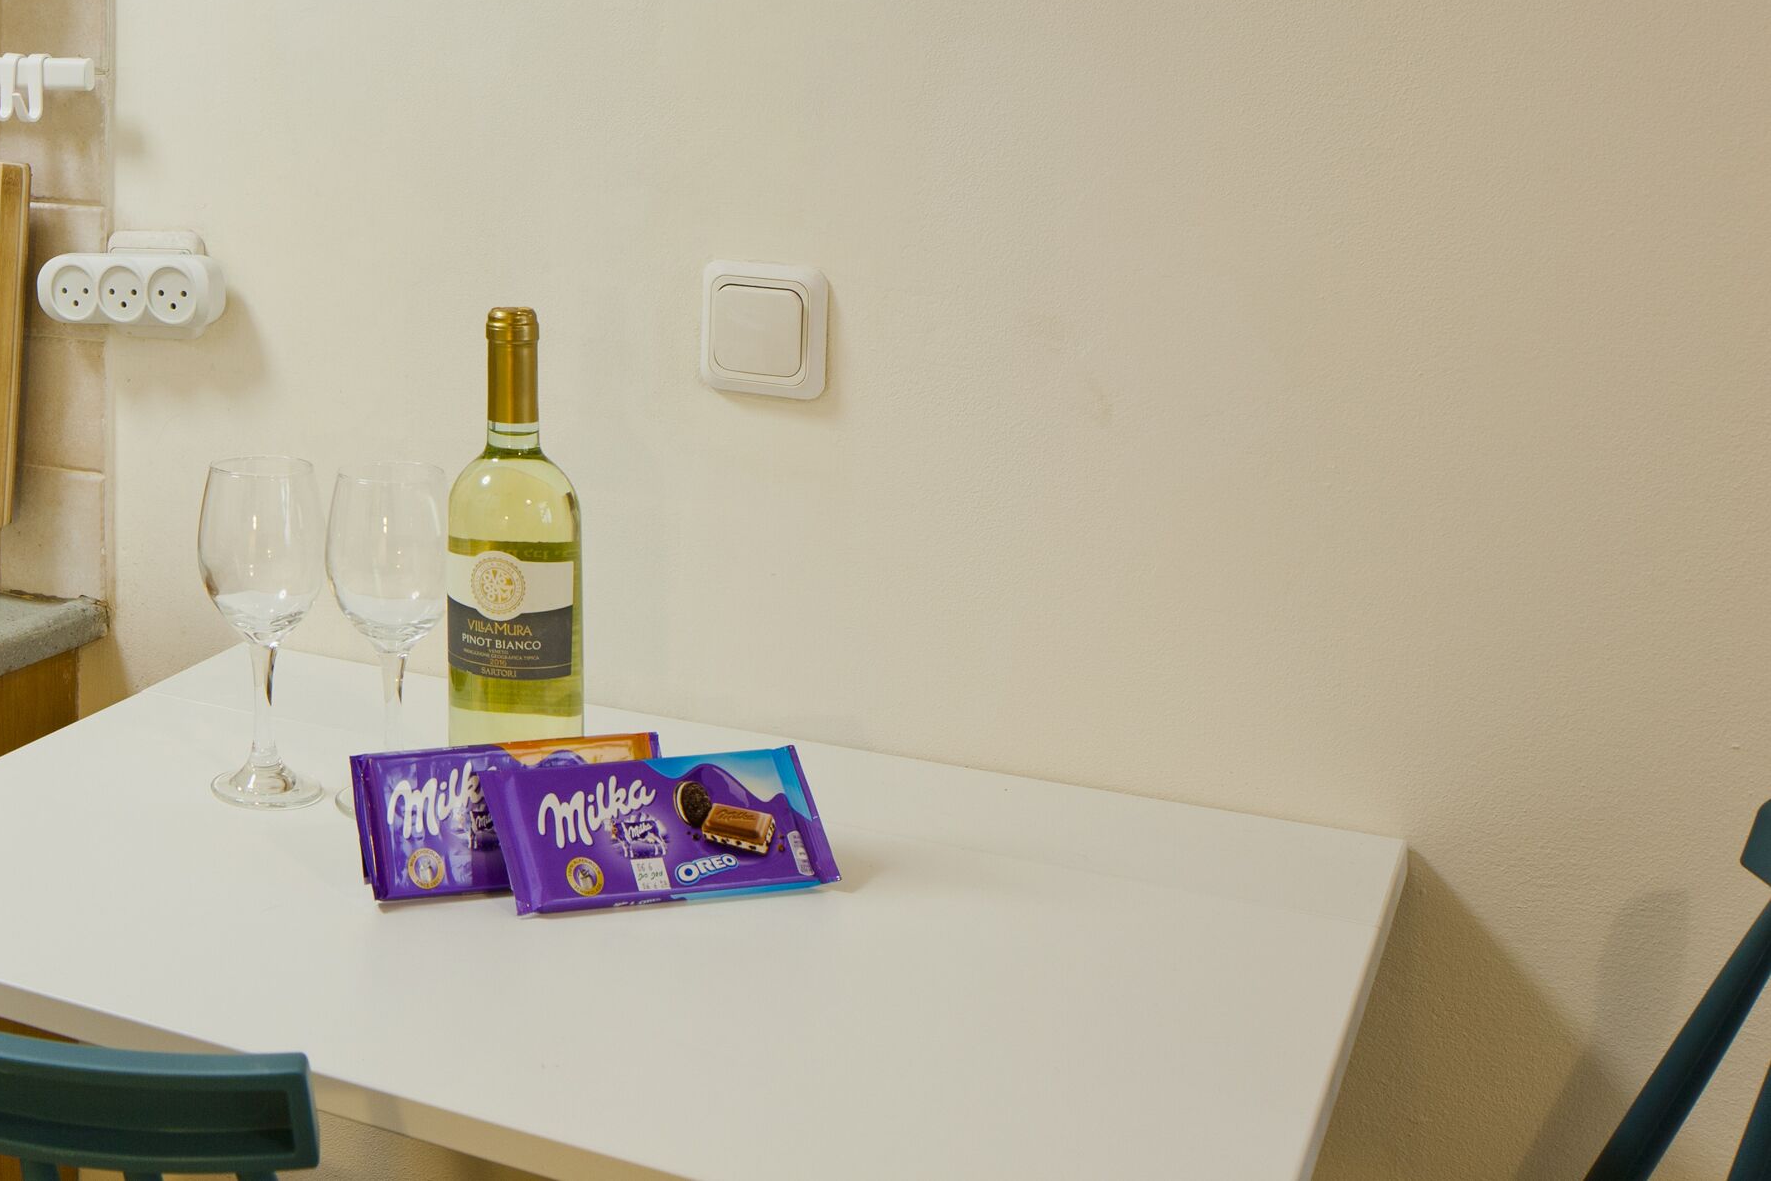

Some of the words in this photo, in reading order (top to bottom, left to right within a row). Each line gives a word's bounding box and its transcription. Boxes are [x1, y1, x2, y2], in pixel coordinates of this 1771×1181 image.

[462, 633, 492, 648] PINOT
[495, 639, 541, 651] BIANCO
[386, 760, 498, 839] Milk
[537, 774, 656, 849] Milka
[628, 822, 654, 839] Milka
[677, 853, 738, 883] OREO
